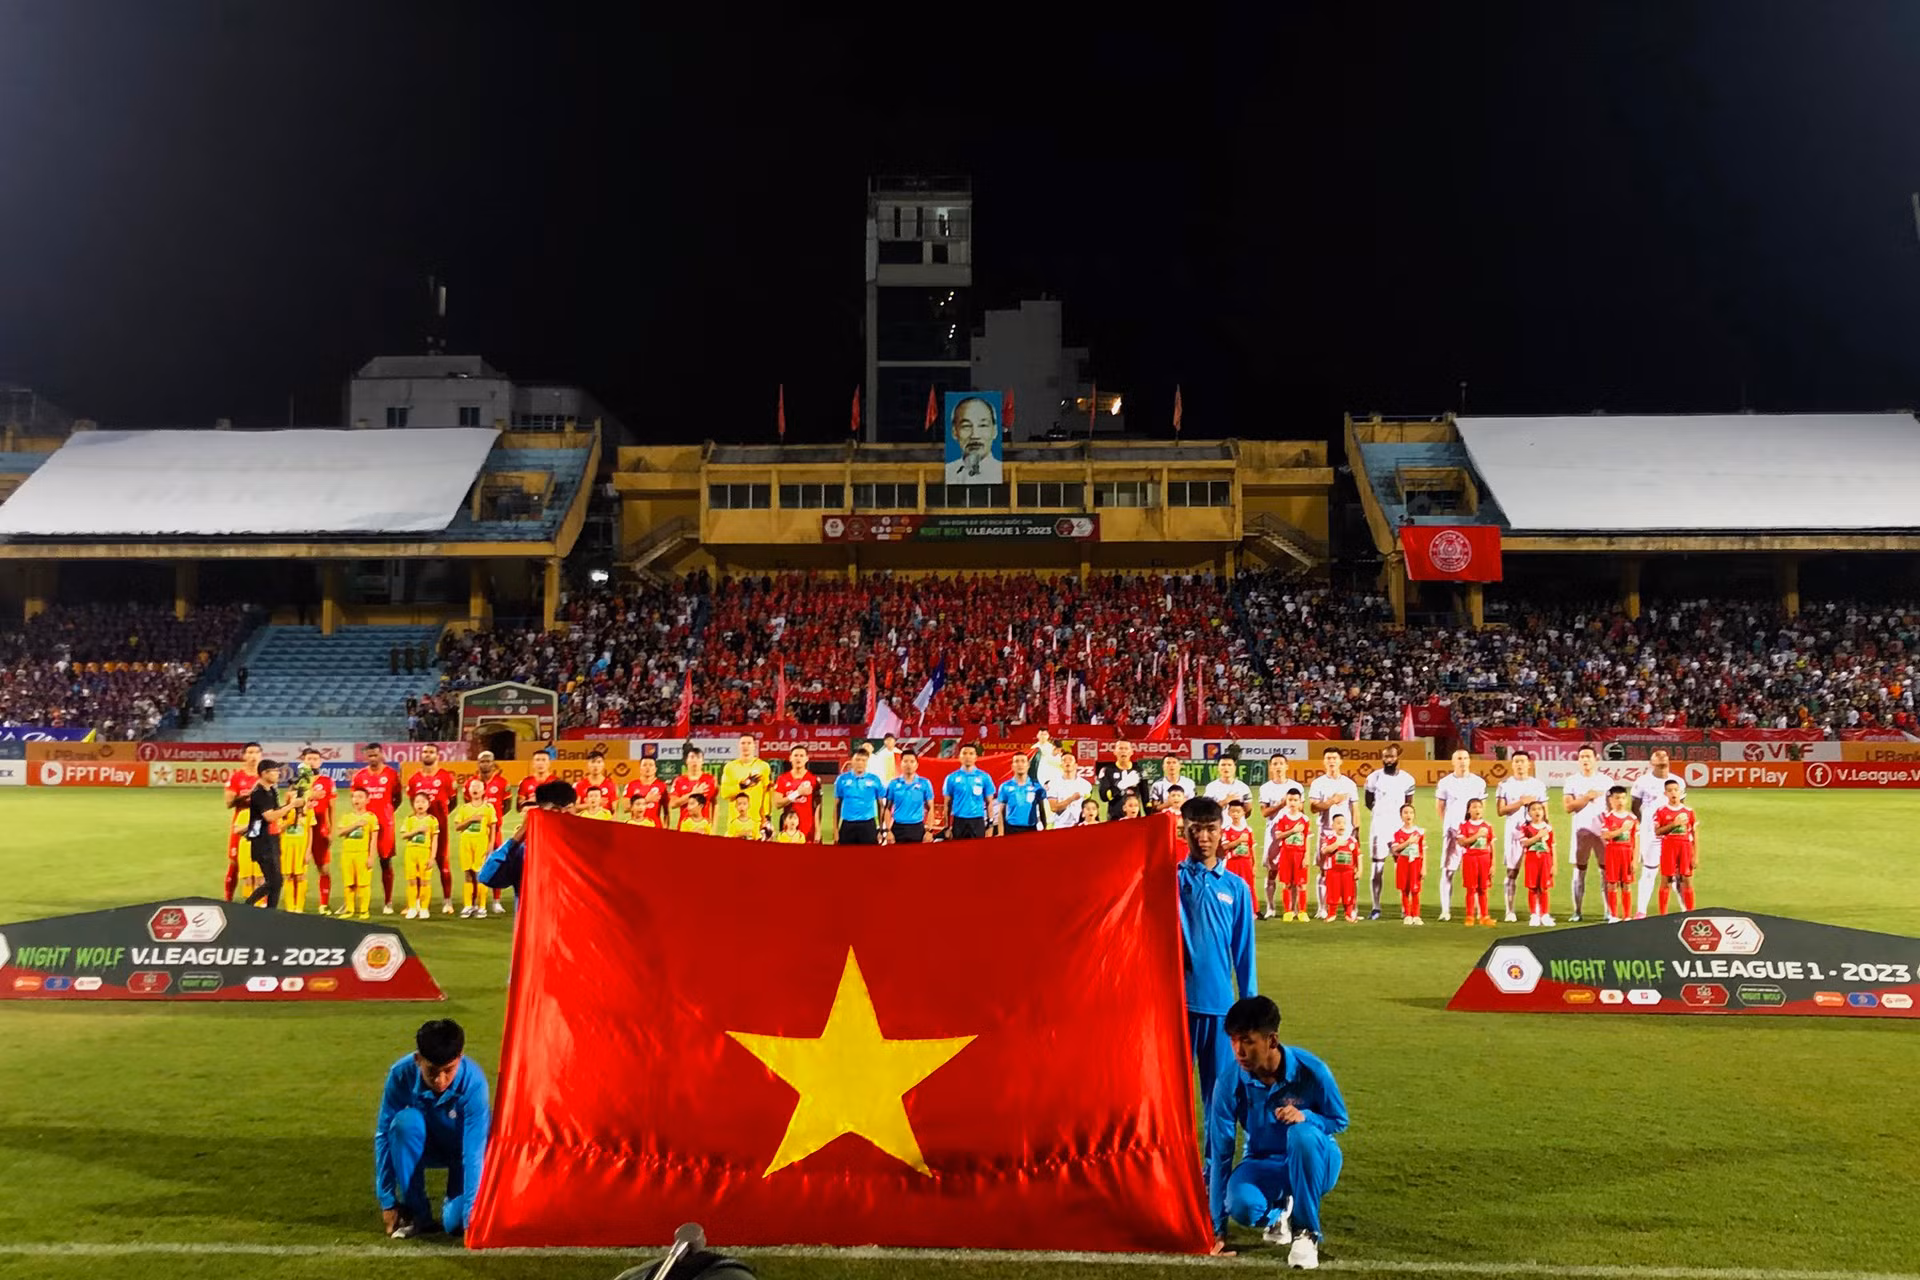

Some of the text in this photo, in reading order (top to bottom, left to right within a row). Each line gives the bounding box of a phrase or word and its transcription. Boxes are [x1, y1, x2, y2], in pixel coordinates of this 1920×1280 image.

[965, 527, 1013, 535] V.LEAGUE
[1026, 526, 1052, 535] 2023
[65, 766, 135, 785] FPT Play
[175, 768, 230, 783] BIA SAO
[1712, 767, 1788, 787] FPT Play
[16, 946, 72, 967] NIGHT
[75, 946, 125, 969] WOLF
[131, 947, 250, 965] V.LEAGUE
[252, 948, 266, 966] 1
[283, 948, 346, 966] 2023
[1550, 959, 1606, 984] NIGHT
[1612, 959, 1666, 985] WOLF
[1672, 960, 1804, 979] V.LEAGUE
[1807, 962, 1825, 980] 1
[1841, 963, 1911, 983] 2023
